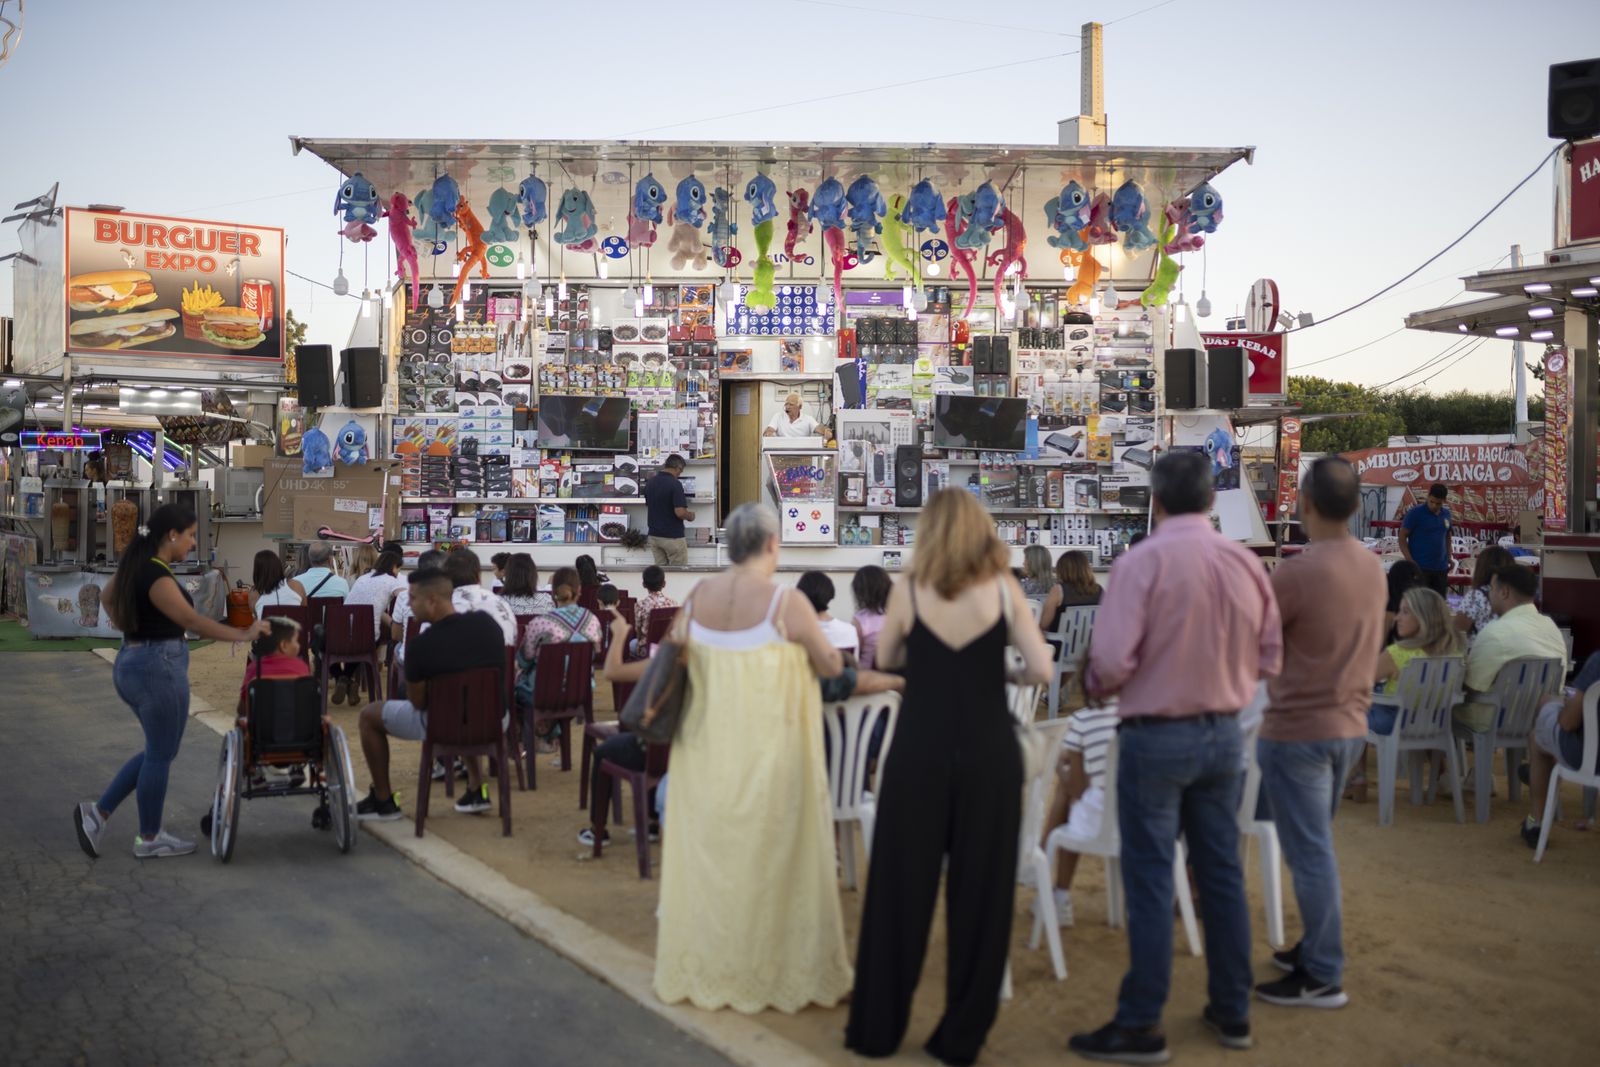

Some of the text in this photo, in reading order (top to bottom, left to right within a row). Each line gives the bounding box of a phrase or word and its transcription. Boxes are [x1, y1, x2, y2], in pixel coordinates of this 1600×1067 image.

[94, 218, 261, 256] BURGUER
[145, 250, 217, 273] EXPO
[767, 253, 815, 266] INO
[1237, 338, 1277, 359] KEBAB
[1423, 463, 1496, 481] URANGA
